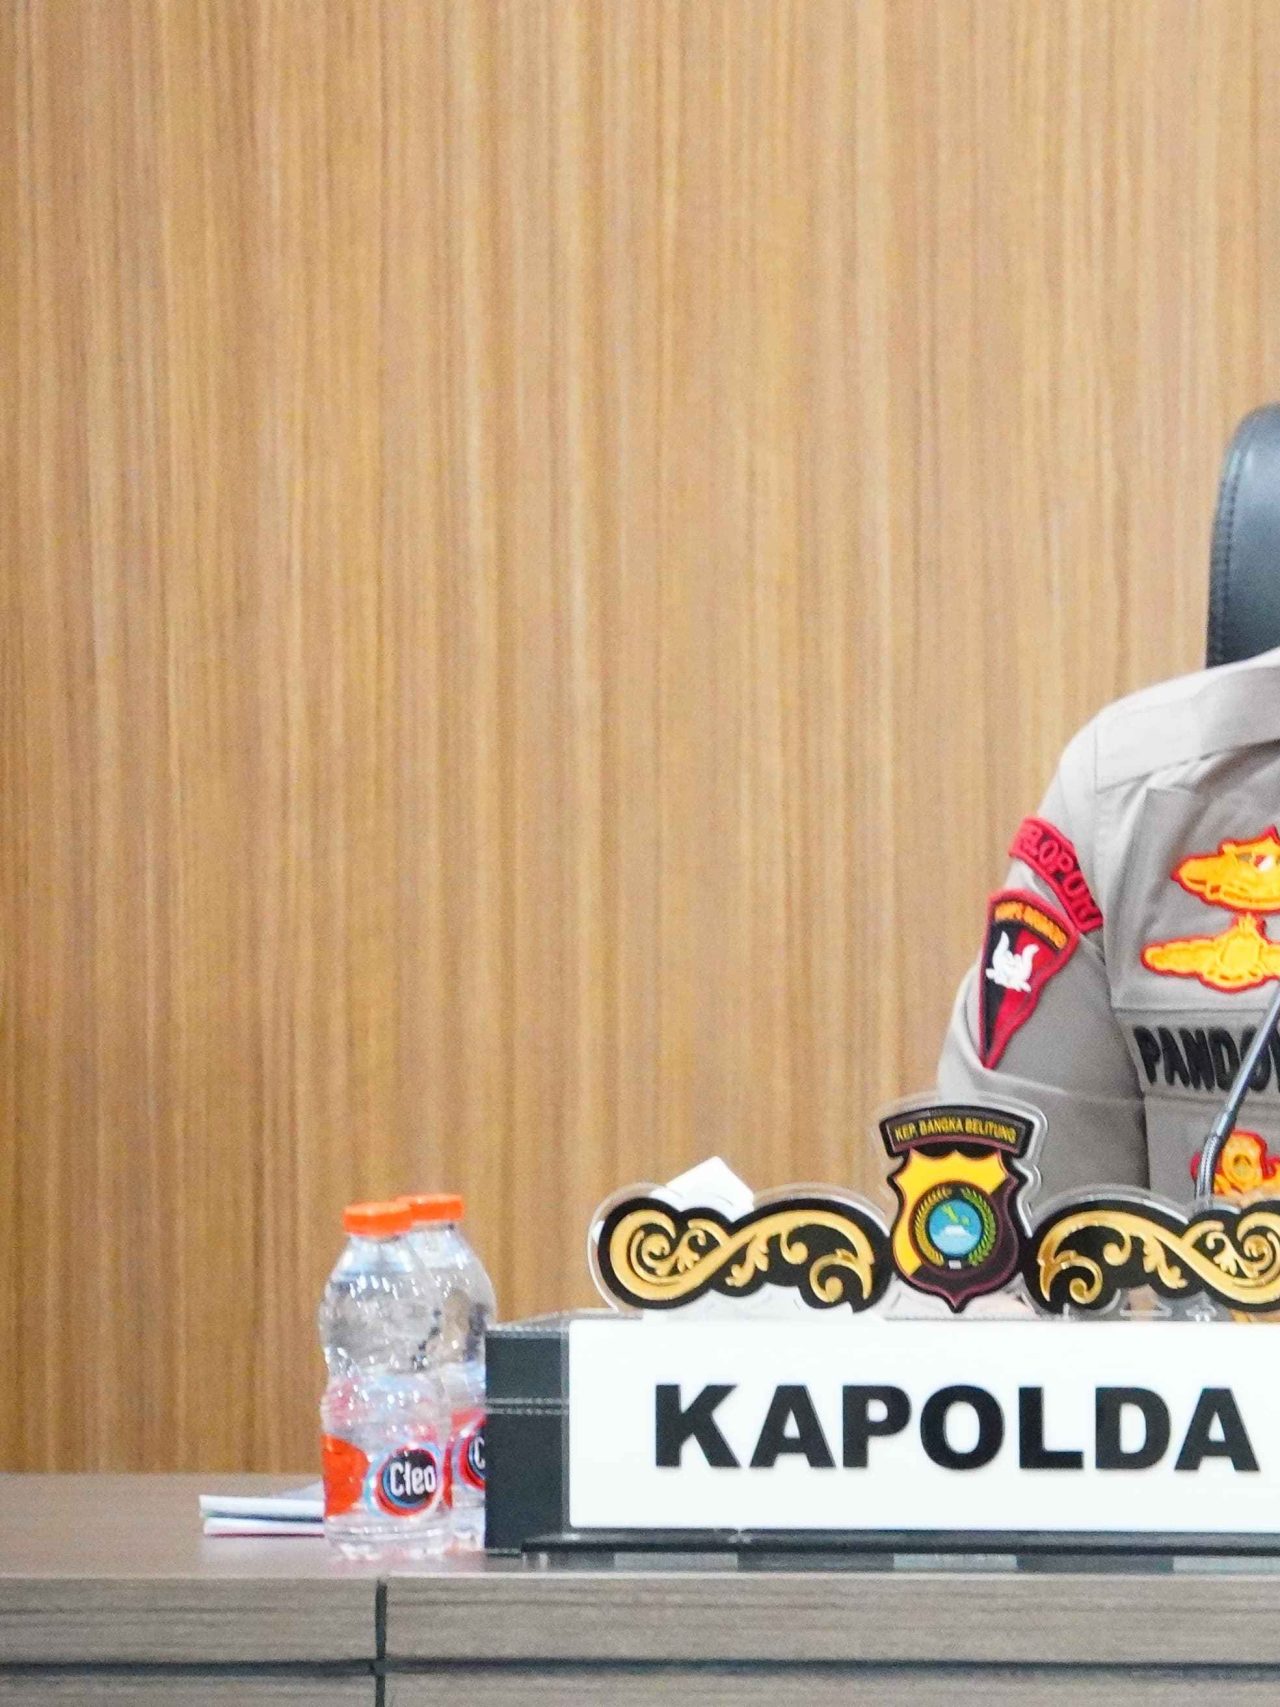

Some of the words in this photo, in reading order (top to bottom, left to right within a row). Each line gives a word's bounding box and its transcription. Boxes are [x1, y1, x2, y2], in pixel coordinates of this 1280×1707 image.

[918, 1117, 963, 1136] BANGKA
[965, 1117, 1017, 1144] BELITUNG
[656, 1384, 1259, 1471] KAPOLDA
[390, 1461, 436, 1496] Cleo
